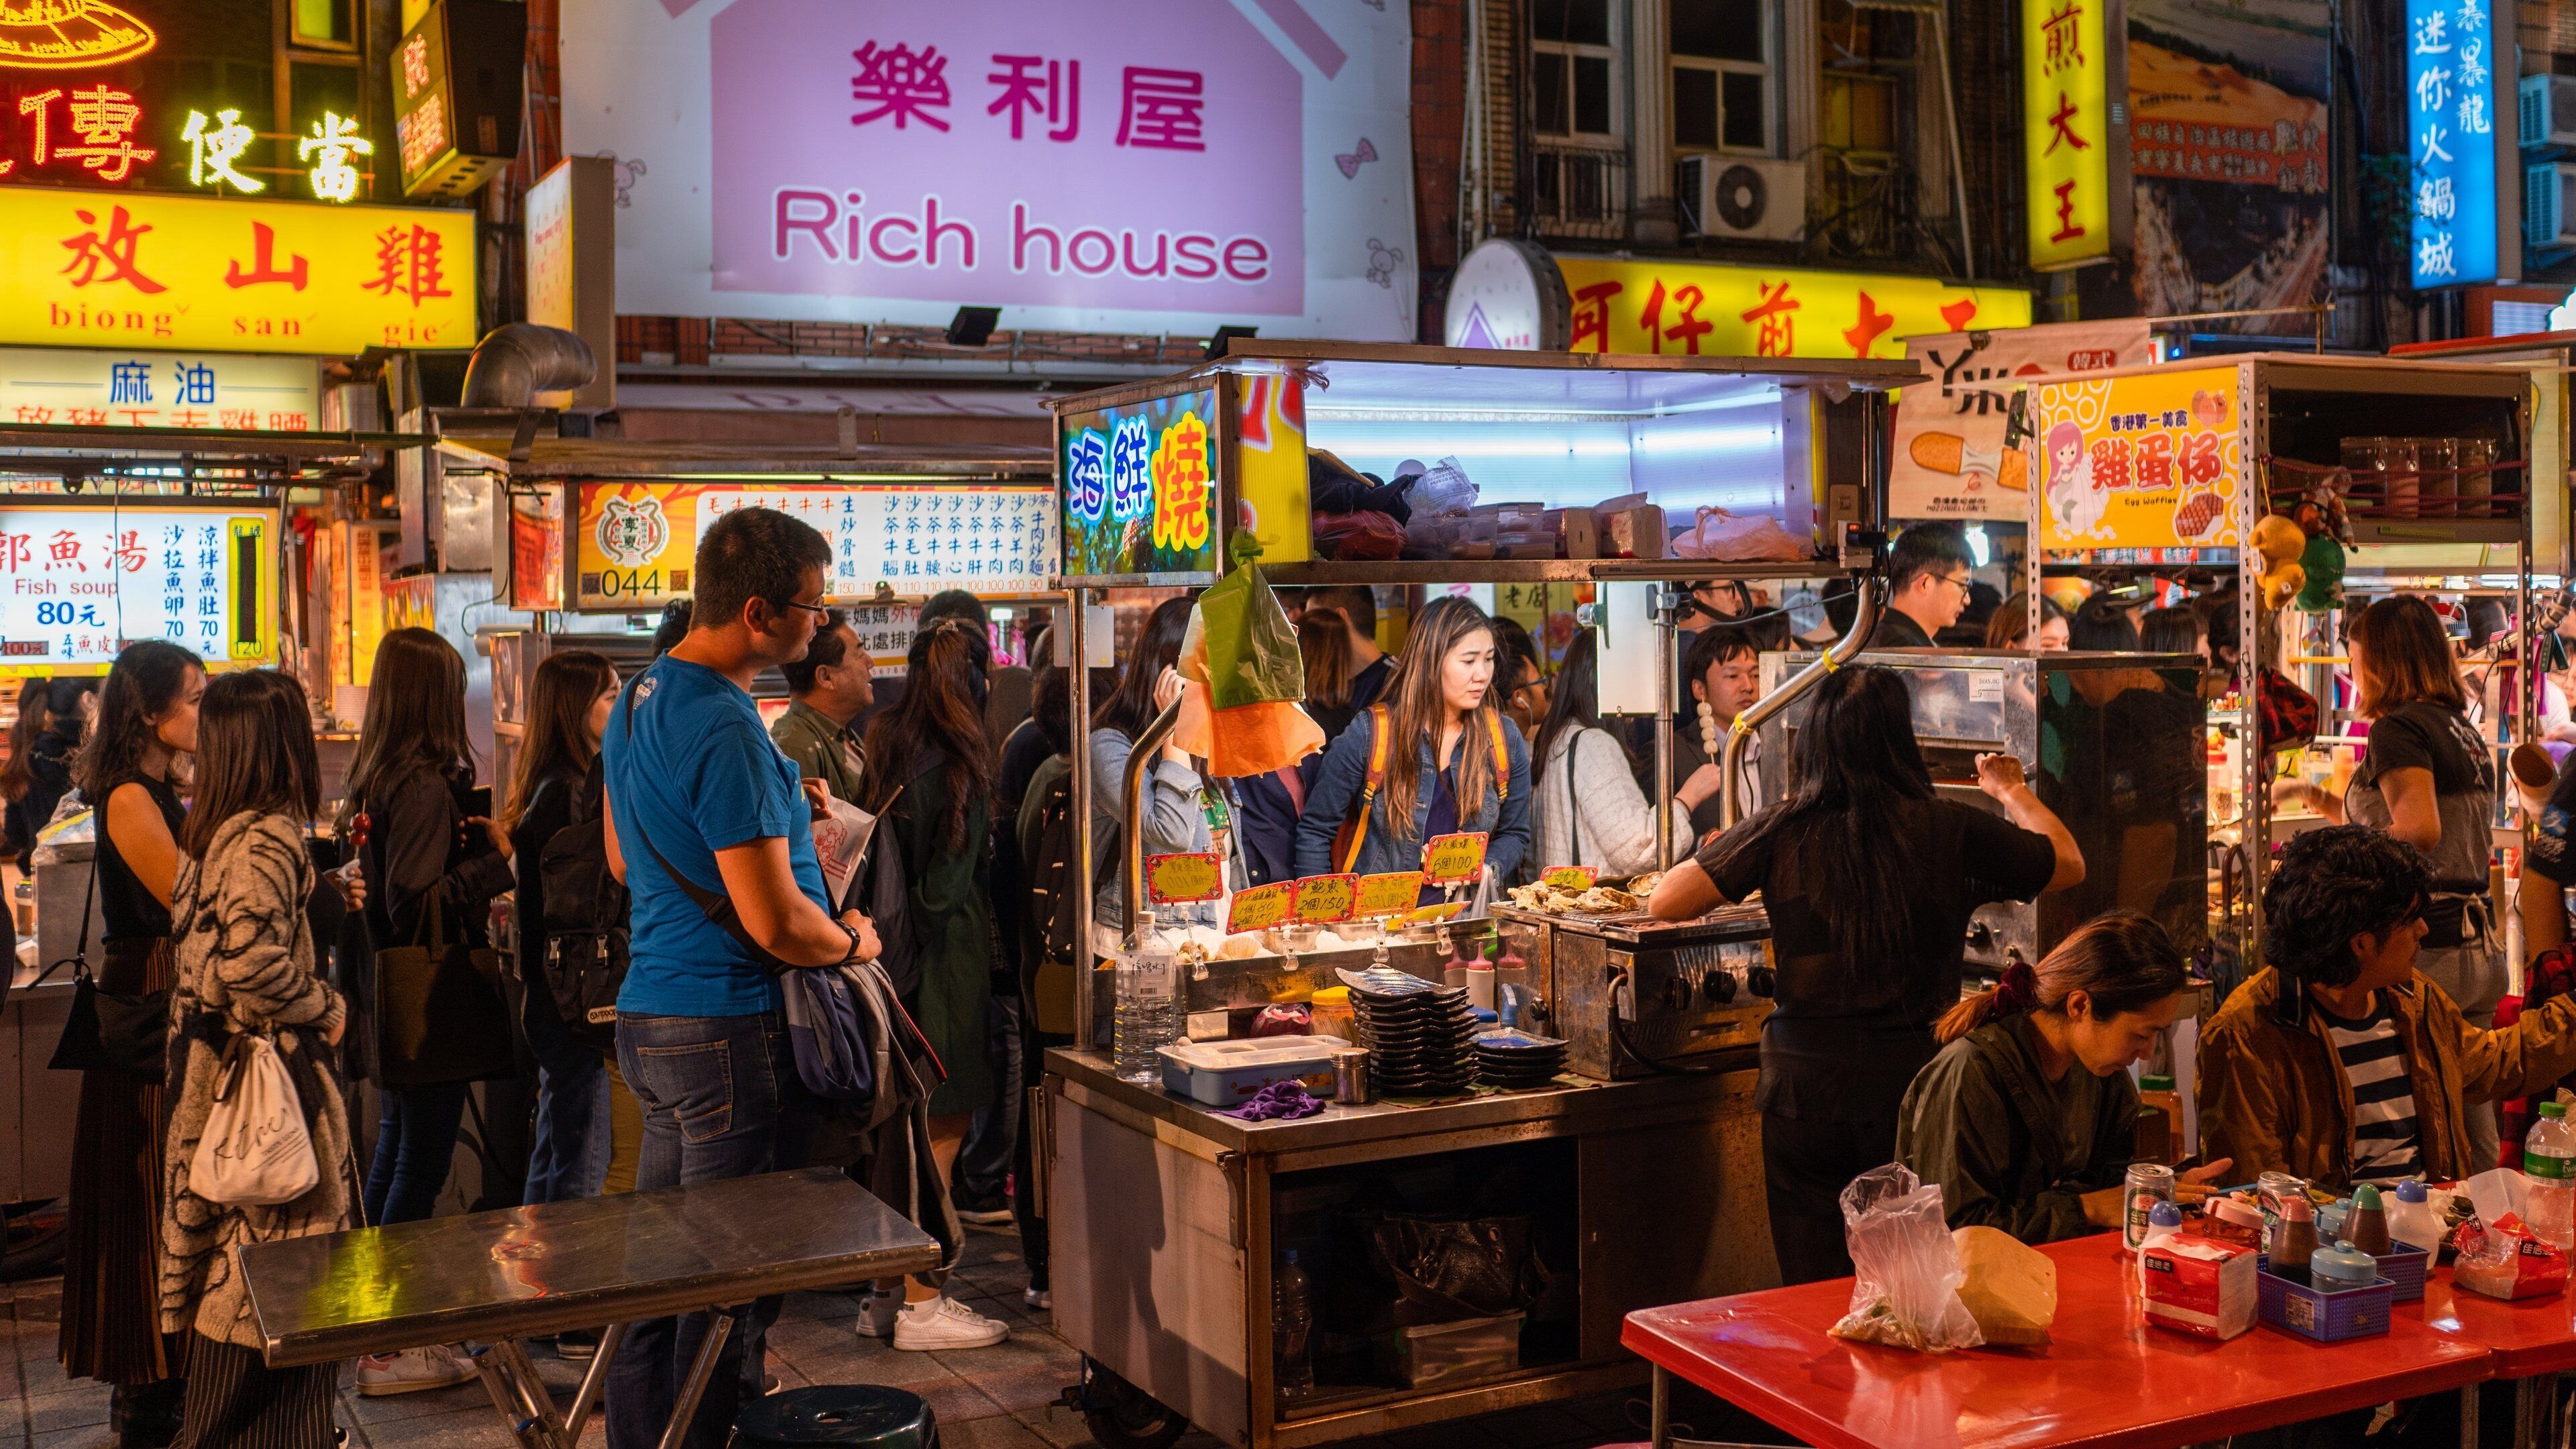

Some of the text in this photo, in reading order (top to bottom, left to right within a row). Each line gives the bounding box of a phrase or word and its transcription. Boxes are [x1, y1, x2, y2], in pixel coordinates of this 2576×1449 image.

[0, 85, 156, 180] 傳
[851, 40, 1205, 152] 樂利屋
[182, 109, 373, 203] 便當
[2415, 9, 2457, 276] 迷你火鍋城
[59, 205, 453, 307] 放山雞
[775, 188, 1269, 282] Rich house
[109, 360, 215, 405] 麻油
[2110, 410, 2188, 431] 香港第一美食
[1071, 417, 1206, 545] 海鮮燒
[2090, 431, 2222, 491] 雞蛋仔
[839, 495, 857, 577] 生炒骨髓
[882, 495, 900, 576] 沙茶牛腦
[904, 495, 922, 576] 沙茶毛肚
[925, 495, 943, 576] 沙茶牛腰
[946, 495, 963, 574] 沙茶牛心
[967, 495, 985, 575] 沙茶牛肝
[988, 495, 1006, 574] 沙茶牛肉
[1009, 495, 1026, 574] 沙茶羊肉
[2125, 496, 2177, 506] Egg Waffles
[15, 580, 118, 598] Fish soup
[38, 601, 105, 627] 80元
[602, 569, 661, 597] 044
[839, 582, 855, 594] 150
[904, 582, 920, 592] 110
[926, 581, 942, 592] 110
[967, 580, 984, 591] 100
[987, 580, 1004, 591] 100
[1008, 579, 1025, 591] 100
[1030, 578, 1043, 590] 90
[1298, 897, 1344, 910] 2個150
[1309, 880, 1339, 895] 鮑魚
